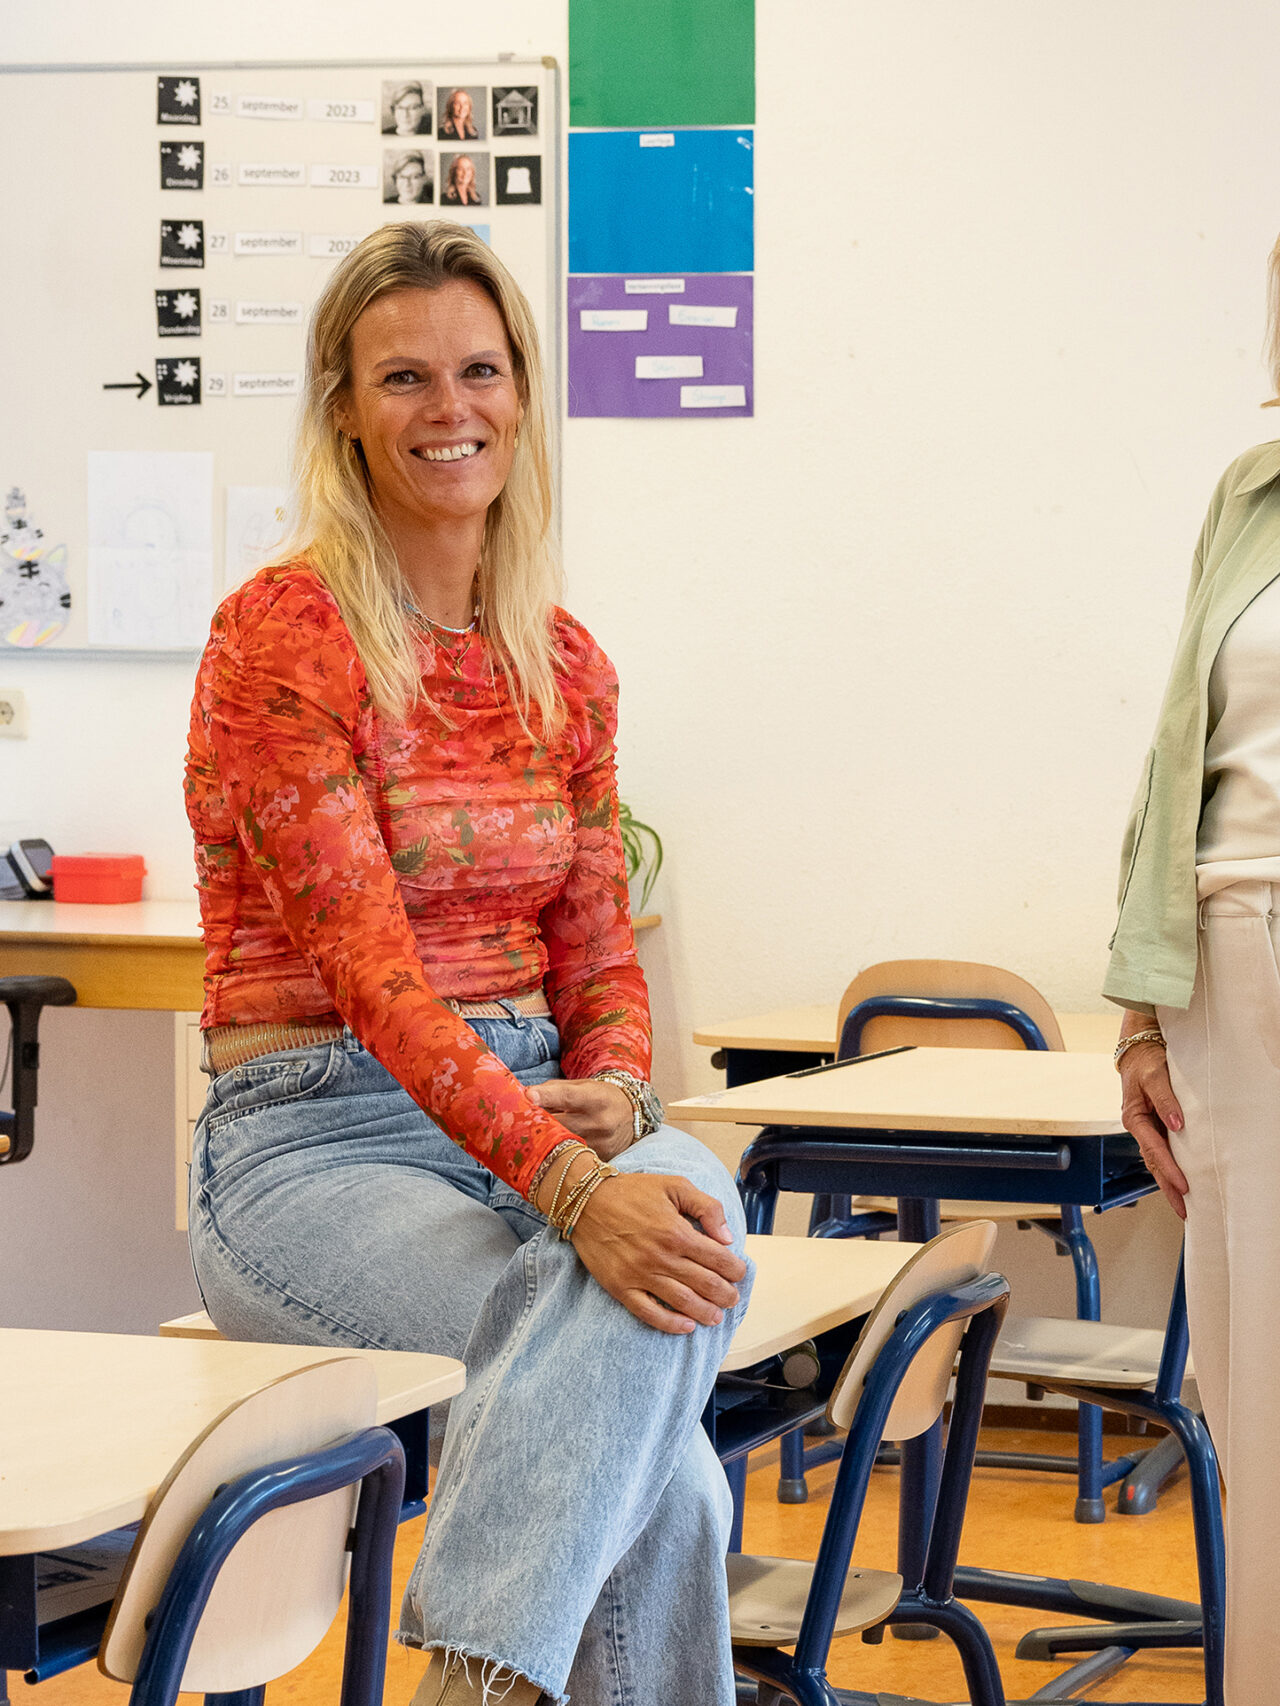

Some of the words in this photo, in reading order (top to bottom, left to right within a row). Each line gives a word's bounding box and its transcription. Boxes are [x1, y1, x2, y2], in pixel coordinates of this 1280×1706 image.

[213, 96, 228, 109] 25
[241, 99, 299, 112] september
[326, 105, 357, 118] 2023
[214, 169, 229, 181] 26
[243, 168, 300, 180] september
[329, 170, 360, 183] 2023
[210, 237, 226, 249] 27
[240, 236, 297, 249] september
[211, 305, 227, 317] 28
[241, 306, 298, 319] september
[208, 379, 223, 391] 29
[238, 376, 295, 390] september
